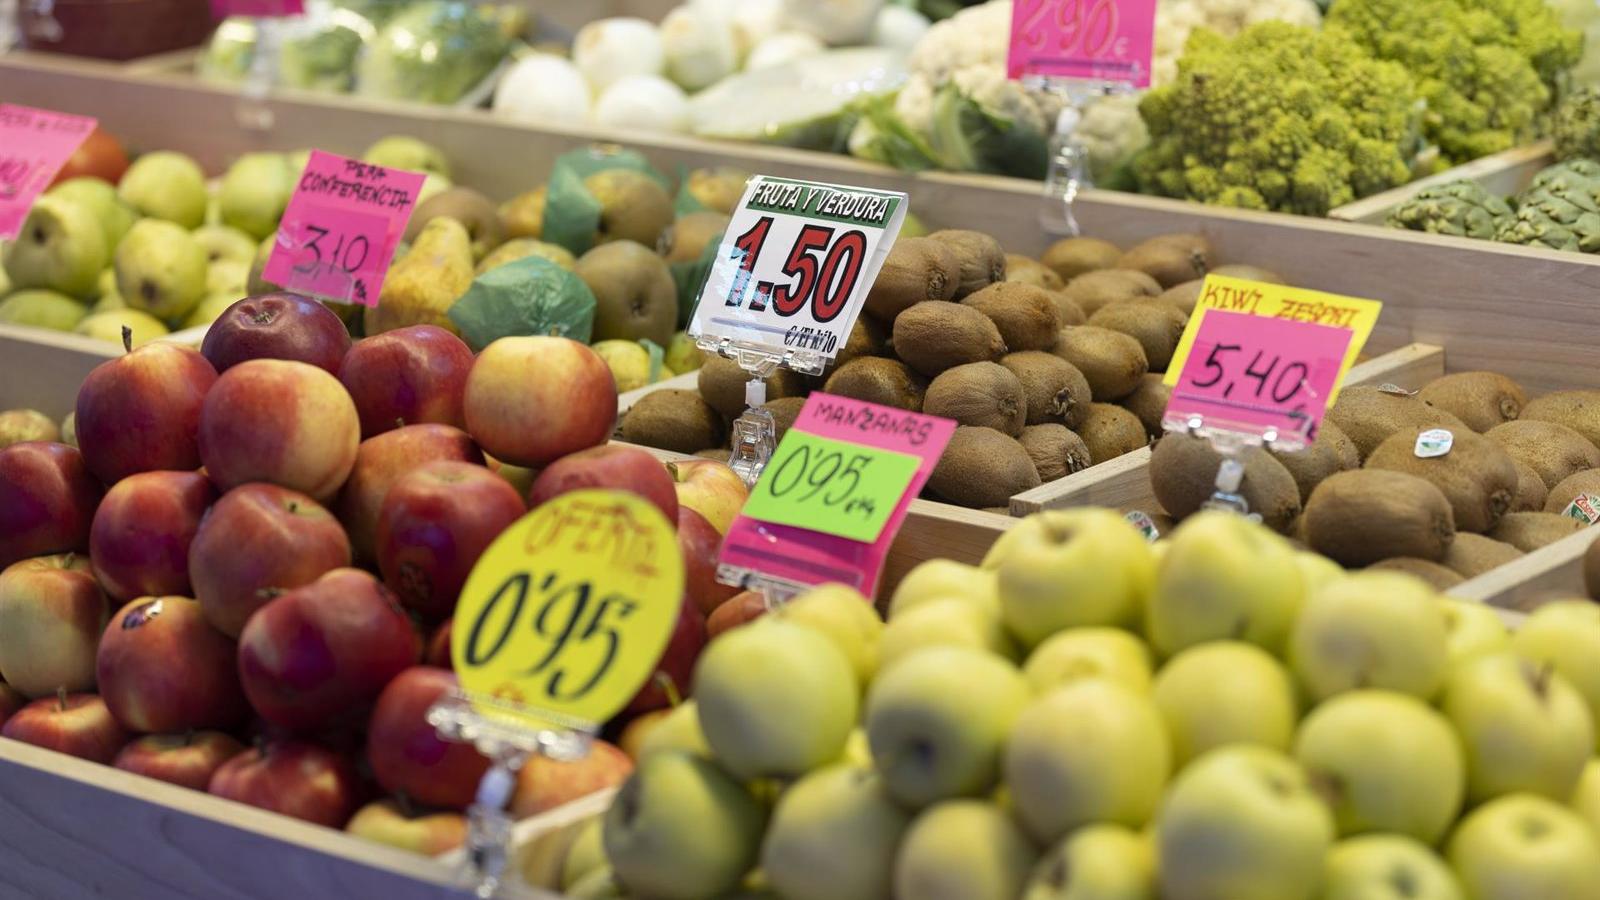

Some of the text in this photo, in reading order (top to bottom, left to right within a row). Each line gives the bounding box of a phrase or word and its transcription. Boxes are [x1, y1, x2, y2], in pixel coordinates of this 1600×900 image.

[300, 171, 411, 211] CONFERENCIA
[749, 182, 890, 223] FRUTA Y VERDURA
[725, 216, 868, 323] 1.50
[1203, 283, 1264, 315] KIWI
[1191, 344, 1308, 404] 5,40
[813, 402, 934, 446] MANZANAS
[769, 445, 875, 507] 0'95
[523, 500, 660, 580] OFERTA
[464, 570, 640, 704] 0'95
